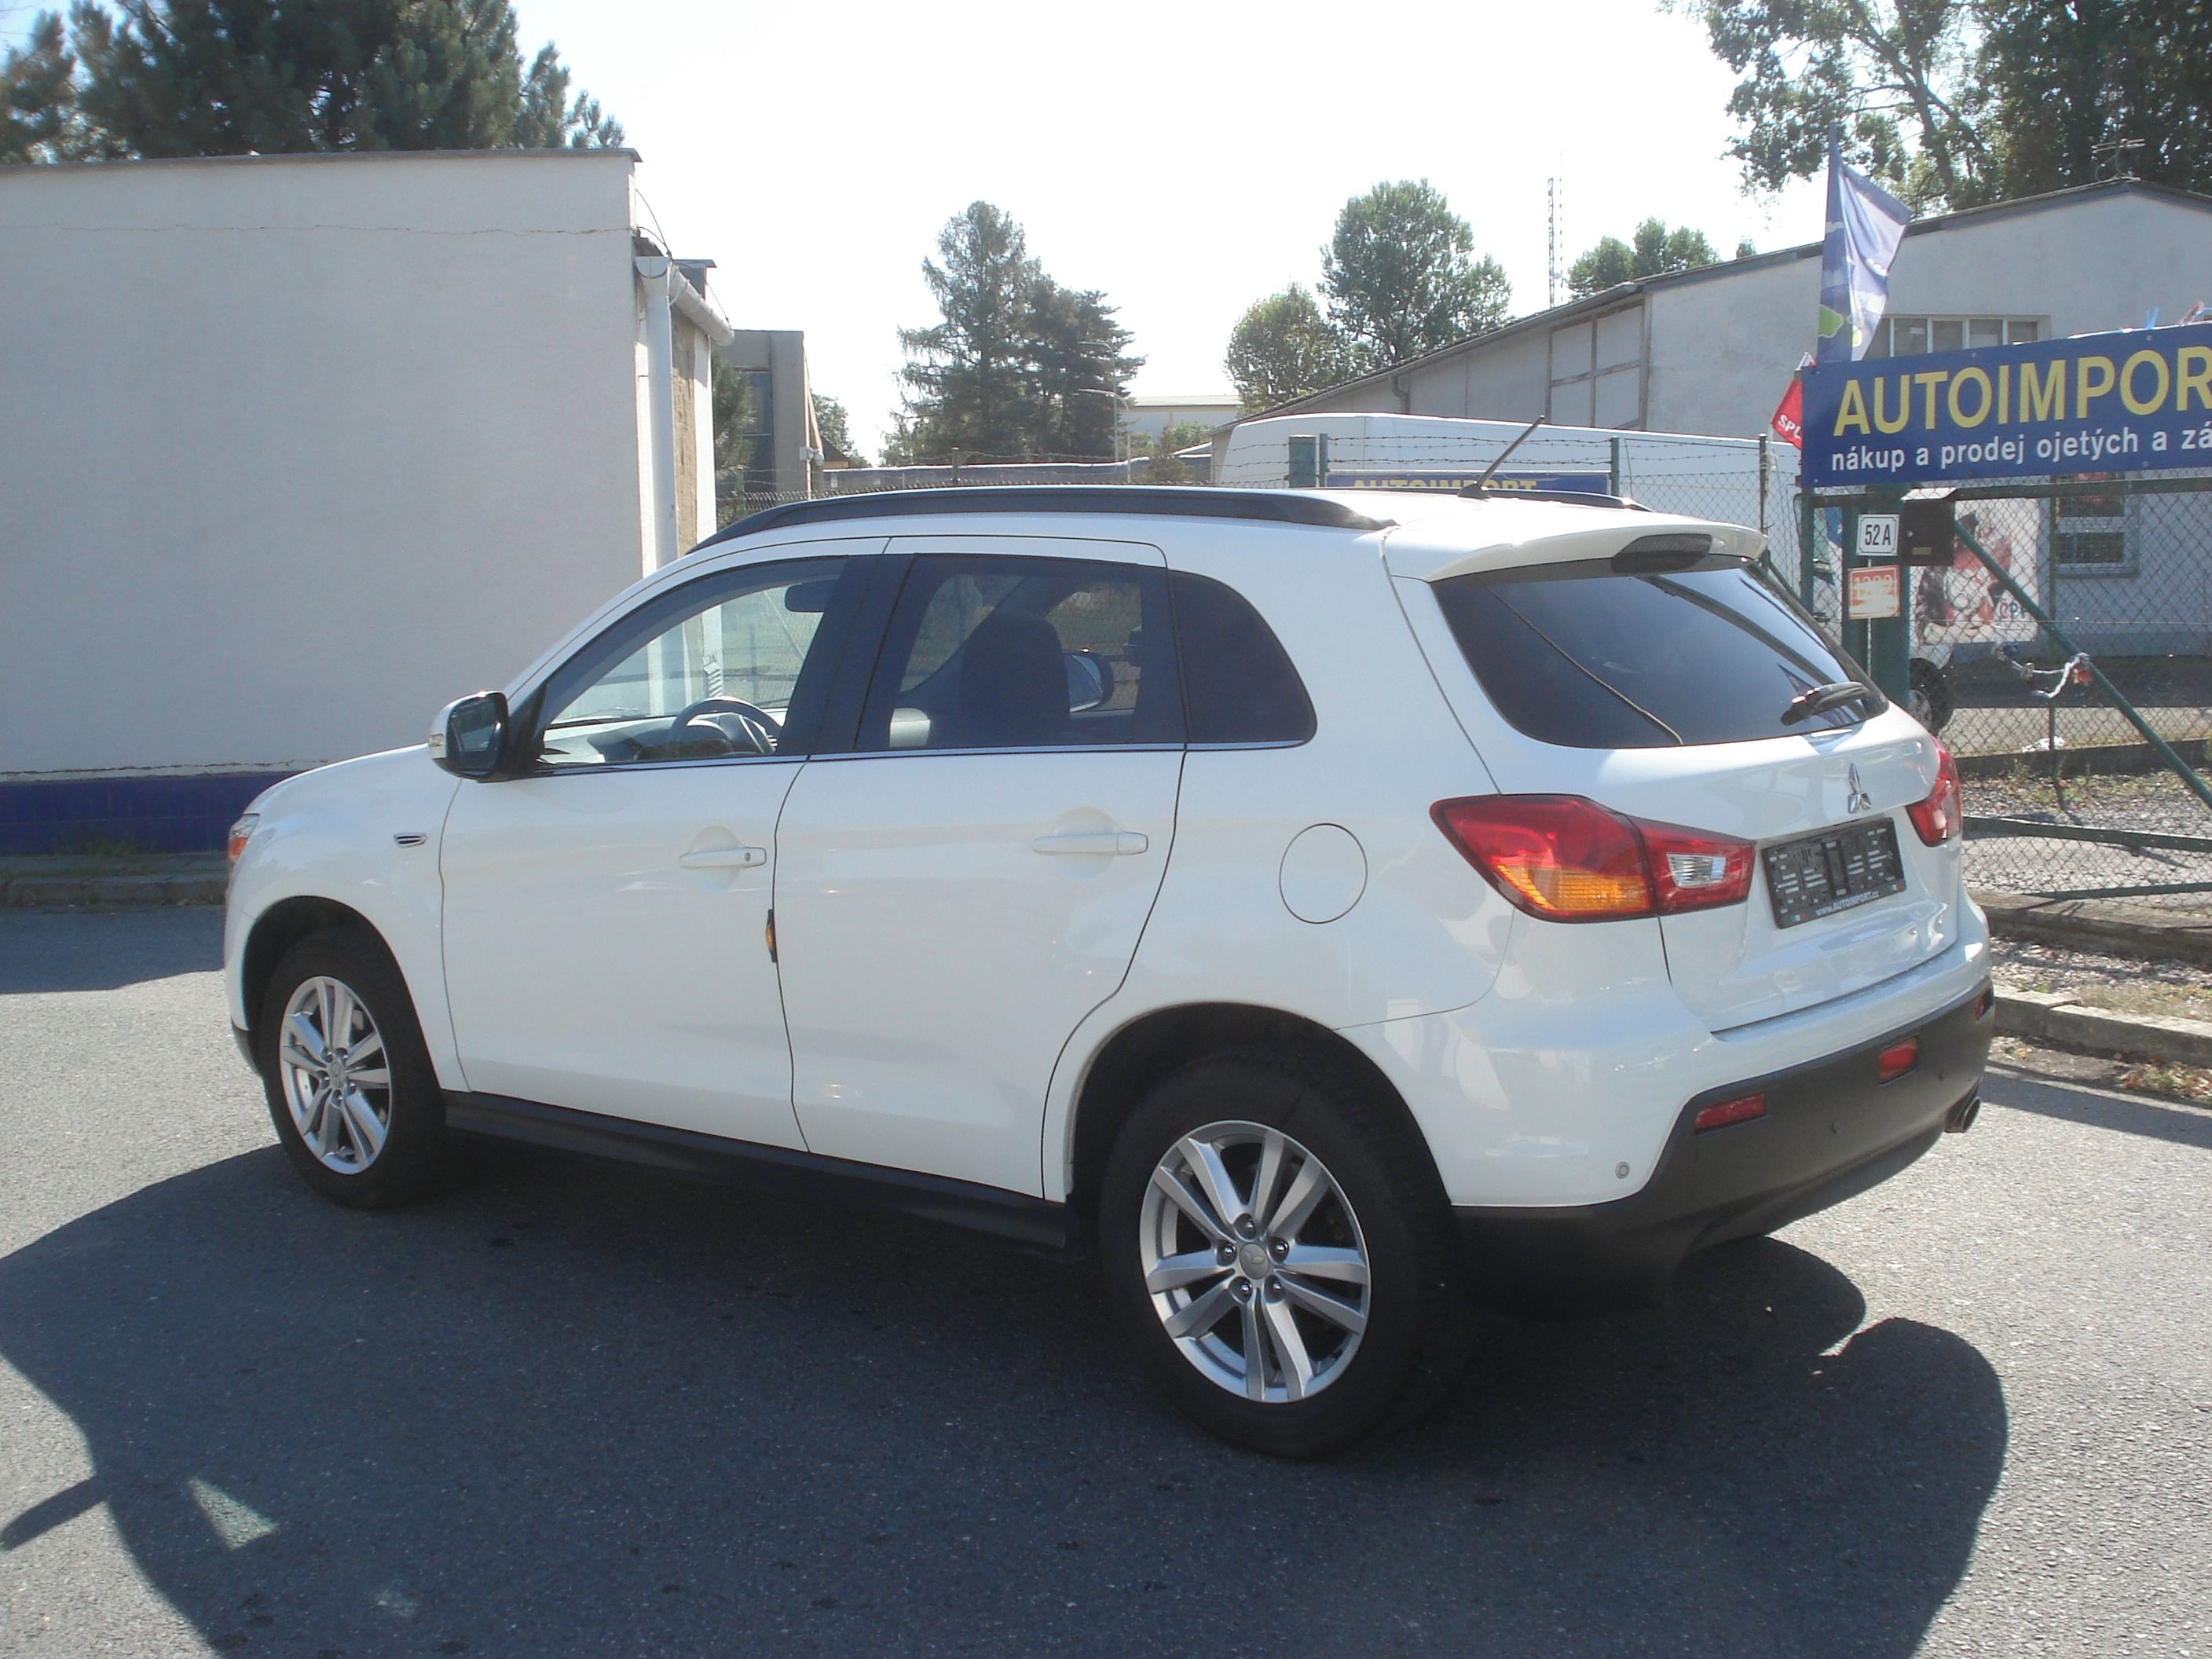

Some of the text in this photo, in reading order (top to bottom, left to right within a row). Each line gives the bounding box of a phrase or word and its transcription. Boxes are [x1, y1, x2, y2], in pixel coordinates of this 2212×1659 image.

[1833, 346, 2212, 437] AUTOIMPOR
[1831, 420, 2212, 472] nákup a prodej ojetých a zá
